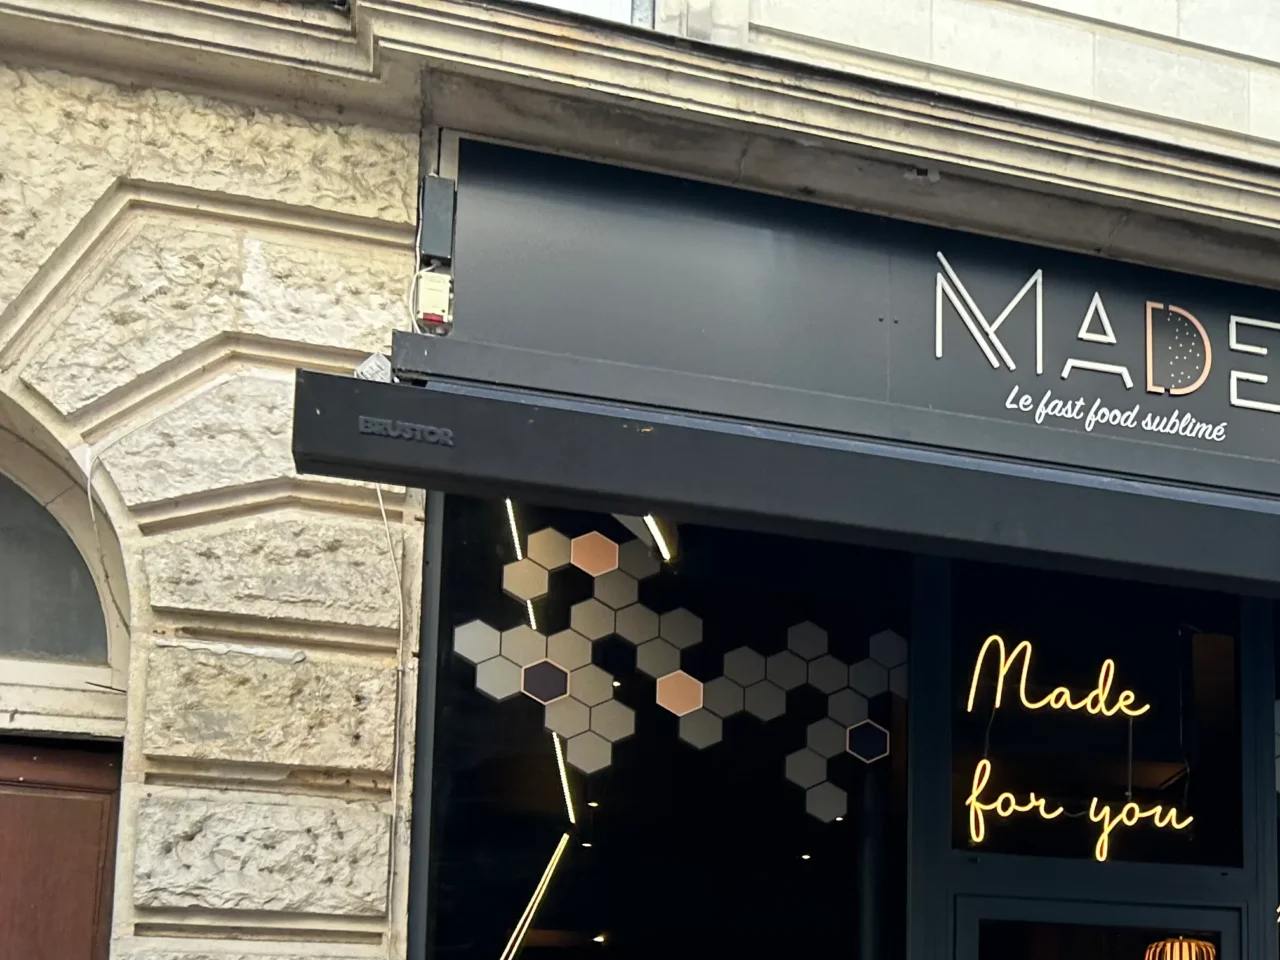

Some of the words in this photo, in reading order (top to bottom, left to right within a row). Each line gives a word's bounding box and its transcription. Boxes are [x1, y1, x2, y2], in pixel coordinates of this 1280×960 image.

[358, 415, 454, 447] BRUSTOR
[1005, 385, 1033, 411] Le
[1034, 389, 1084, 424] fast
[1084, 398, 1138, 431] food
[1141, 412, 1228, 442] sublimé
[967, 634, 1151, 717] Made
[965, 758, 1065, 843] for
[1088, 796, 1194, 862] you
